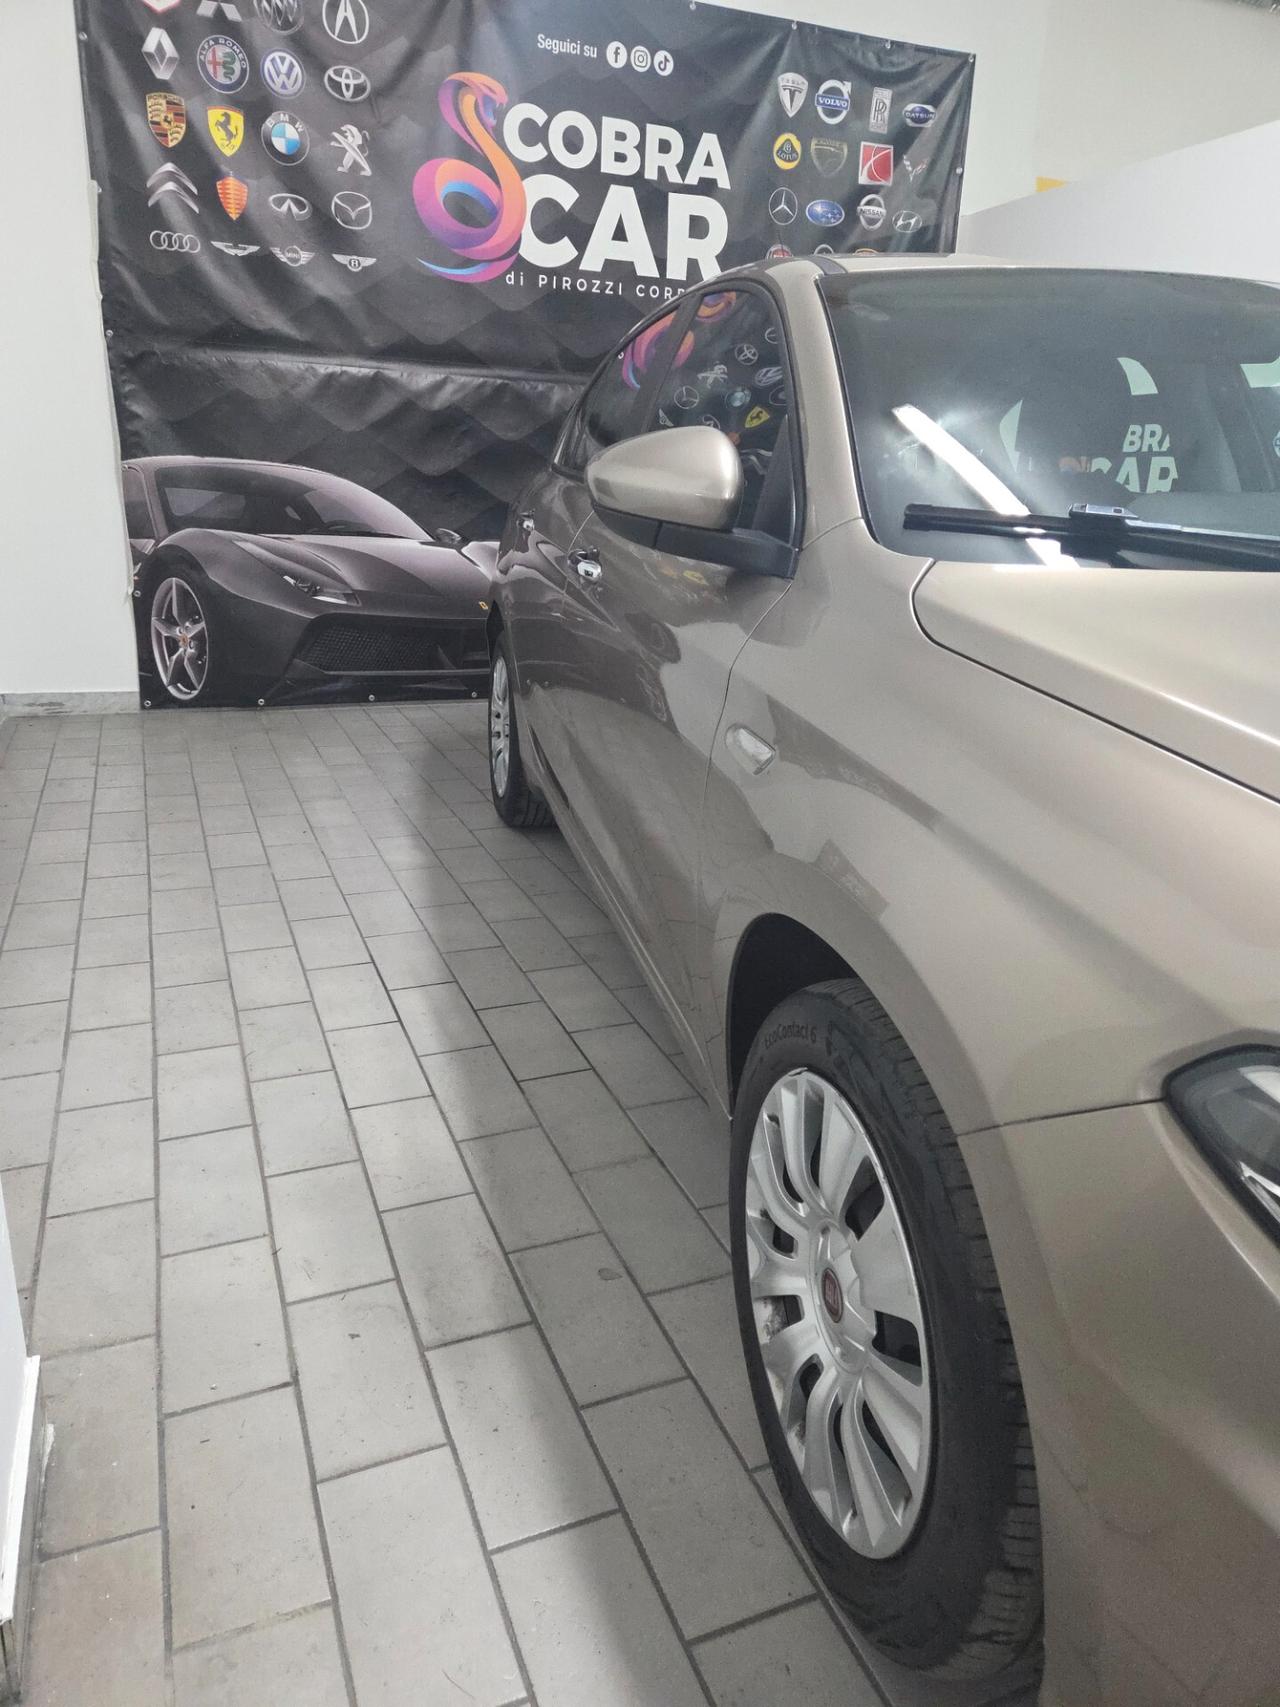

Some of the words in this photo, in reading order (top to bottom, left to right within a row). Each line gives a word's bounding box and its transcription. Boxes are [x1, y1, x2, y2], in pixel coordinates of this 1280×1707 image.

[199, 39, 215, 62] ALFA
[219, 38, 247, 69] ROMEO
[537, 33, 581, 57] Seguici
[583, 44, 598, 58] su
[818, 97, 848, 107] VOLVO
[265, 113, 304, 132] BMW
[503, 103, 731, 190] COBRA
[518, 173, 730, 282] CAR
[506, 272, 524, 287] di
[539, 275, 623, 296] PIROZZI
[810, 1025, 818, 1045] 6
